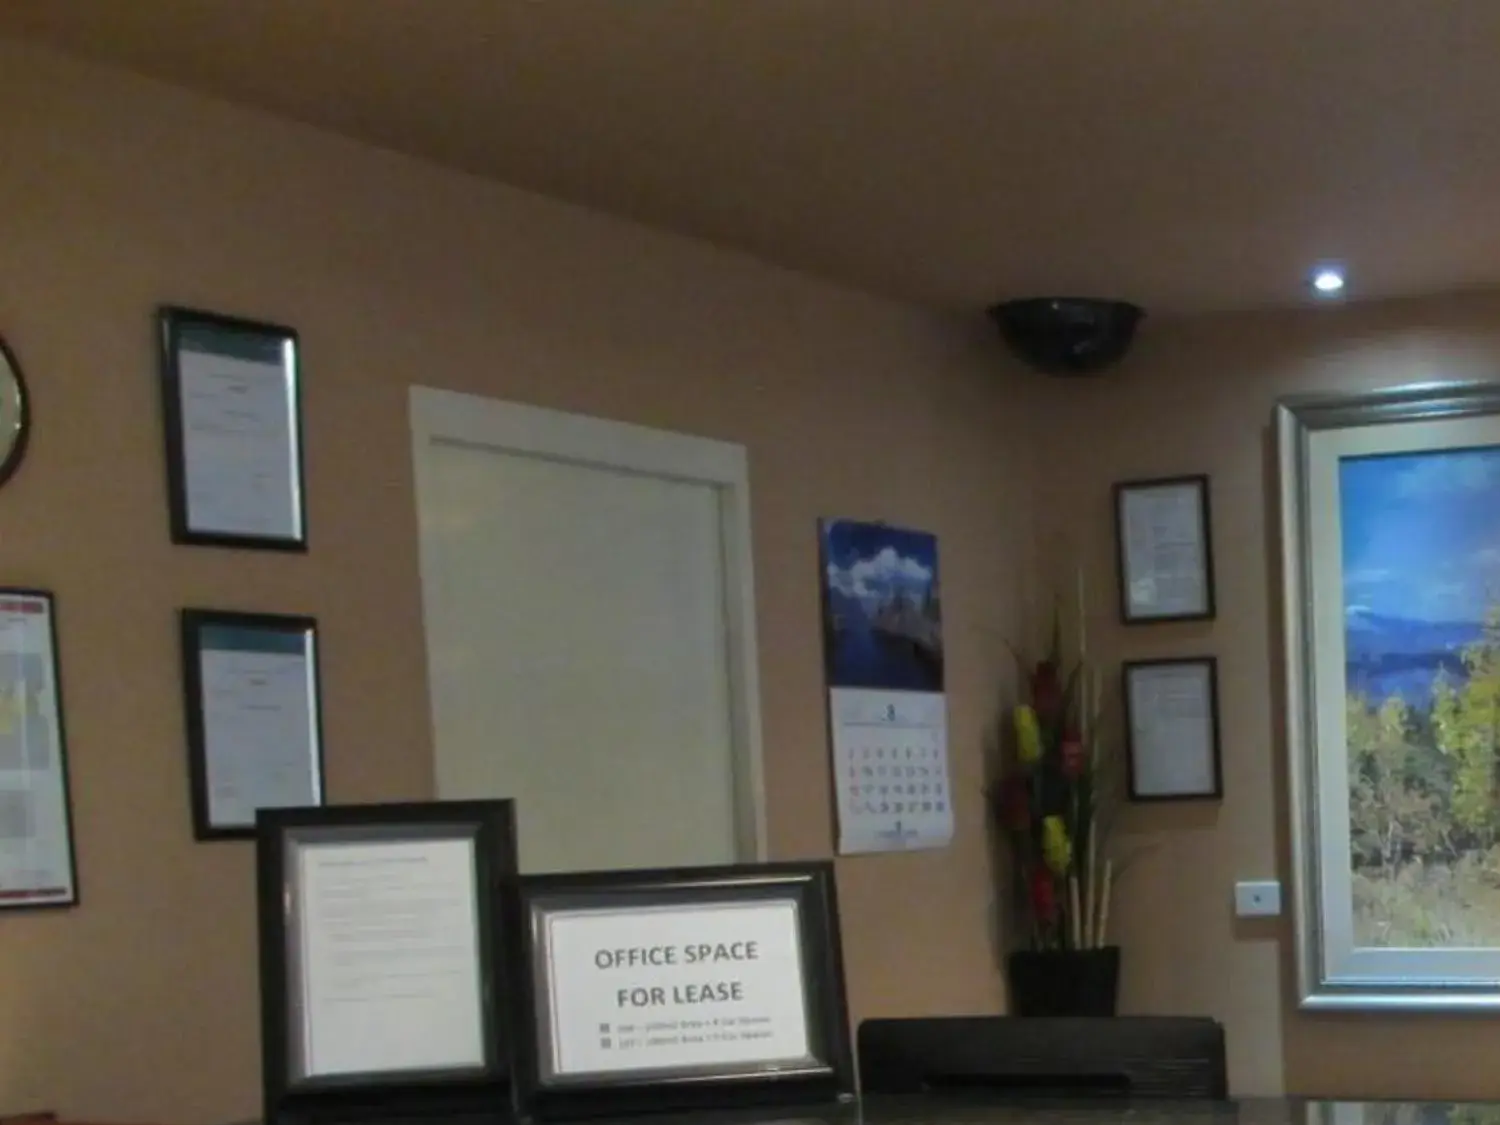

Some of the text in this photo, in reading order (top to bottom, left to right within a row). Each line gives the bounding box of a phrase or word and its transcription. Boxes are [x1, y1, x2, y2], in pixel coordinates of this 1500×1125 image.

[594, 940, 759, 970] OFFICE SPACE
[617, 981, 743, 1008] FOR LEASE
